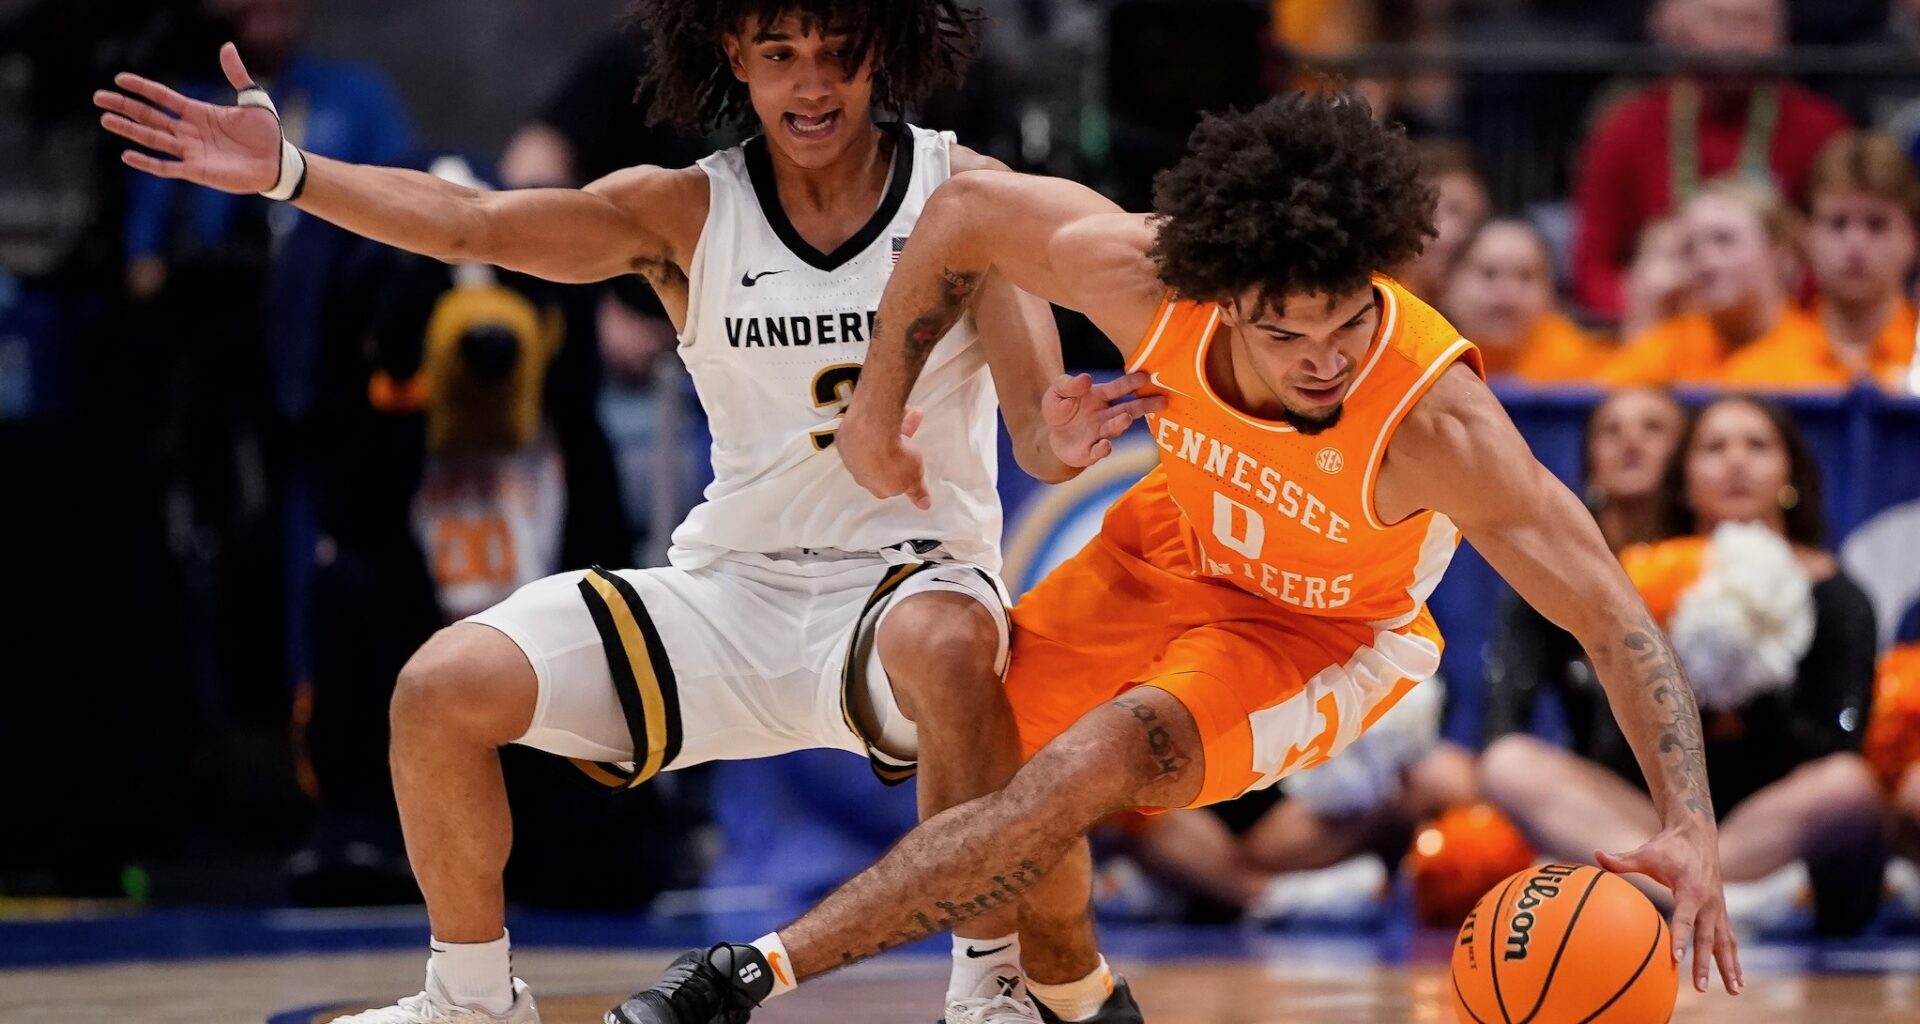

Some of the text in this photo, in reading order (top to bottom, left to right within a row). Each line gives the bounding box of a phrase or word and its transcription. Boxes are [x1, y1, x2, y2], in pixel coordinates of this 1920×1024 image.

[1145, 412, 1349, 543] ENNESSEE
[1317, 448, 1342, 472] SEC
[1212, 491, 1265, 560] 0
